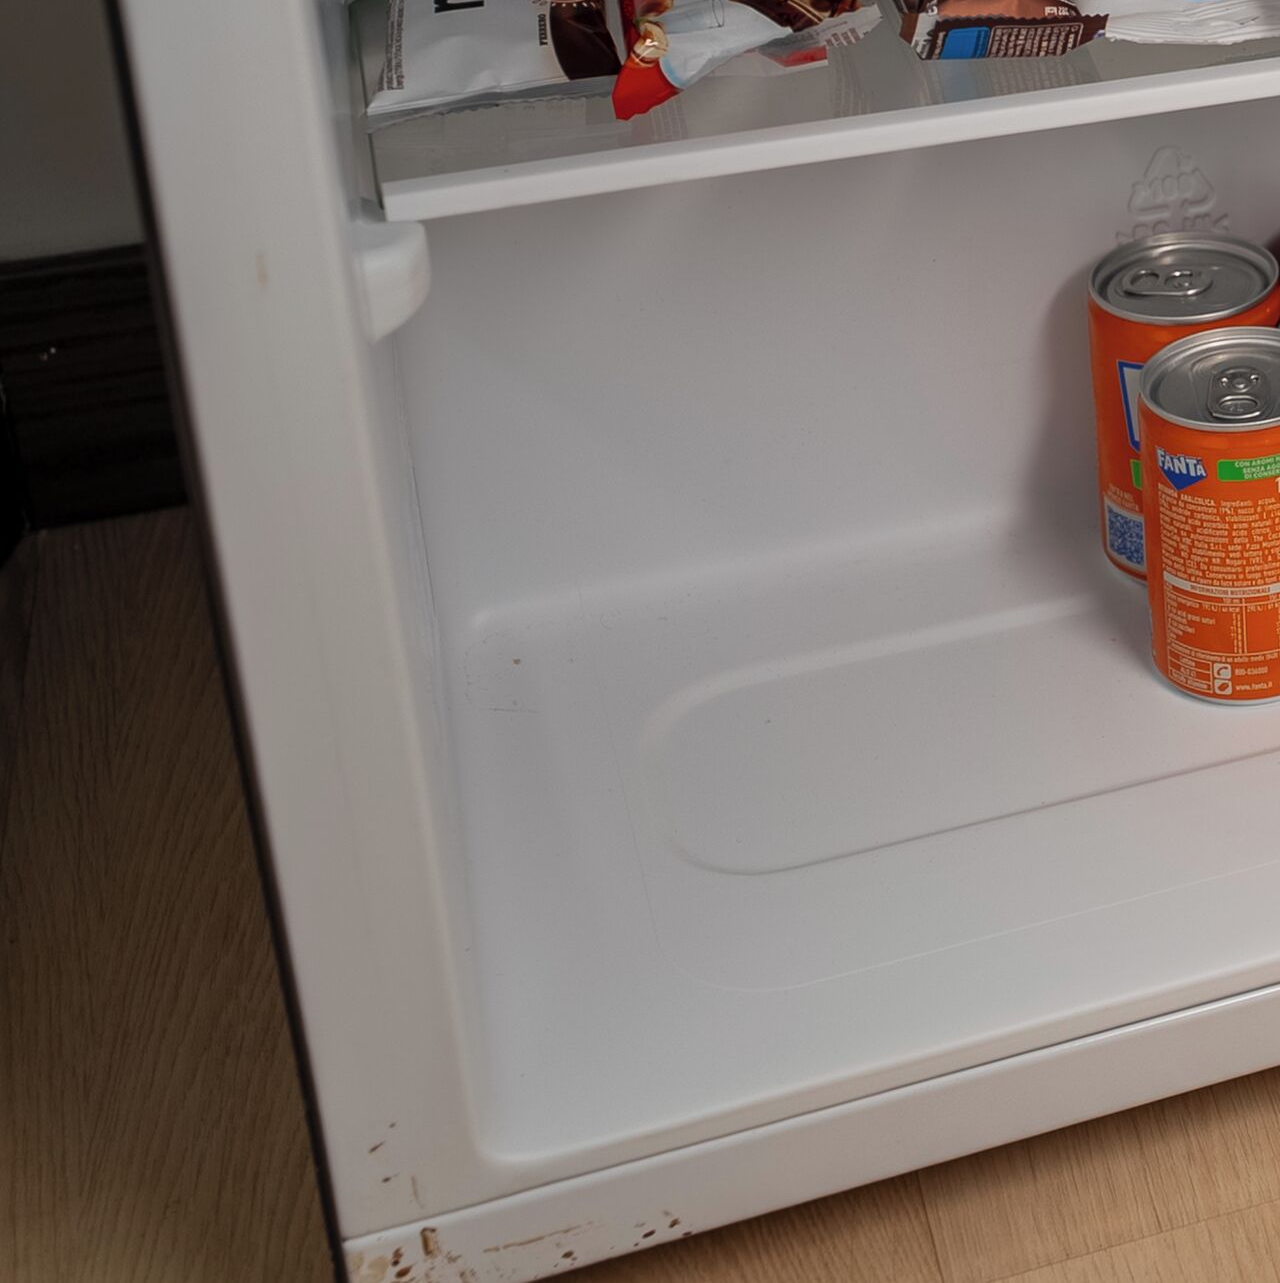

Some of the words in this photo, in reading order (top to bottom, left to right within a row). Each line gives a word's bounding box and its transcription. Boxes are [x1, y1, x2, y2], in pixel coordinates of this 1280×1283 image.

[1154, 448, 1207, 478] FANTA
[1234, 460, 1252, 468] CON
[1243, 472, 1252, 480] DI
